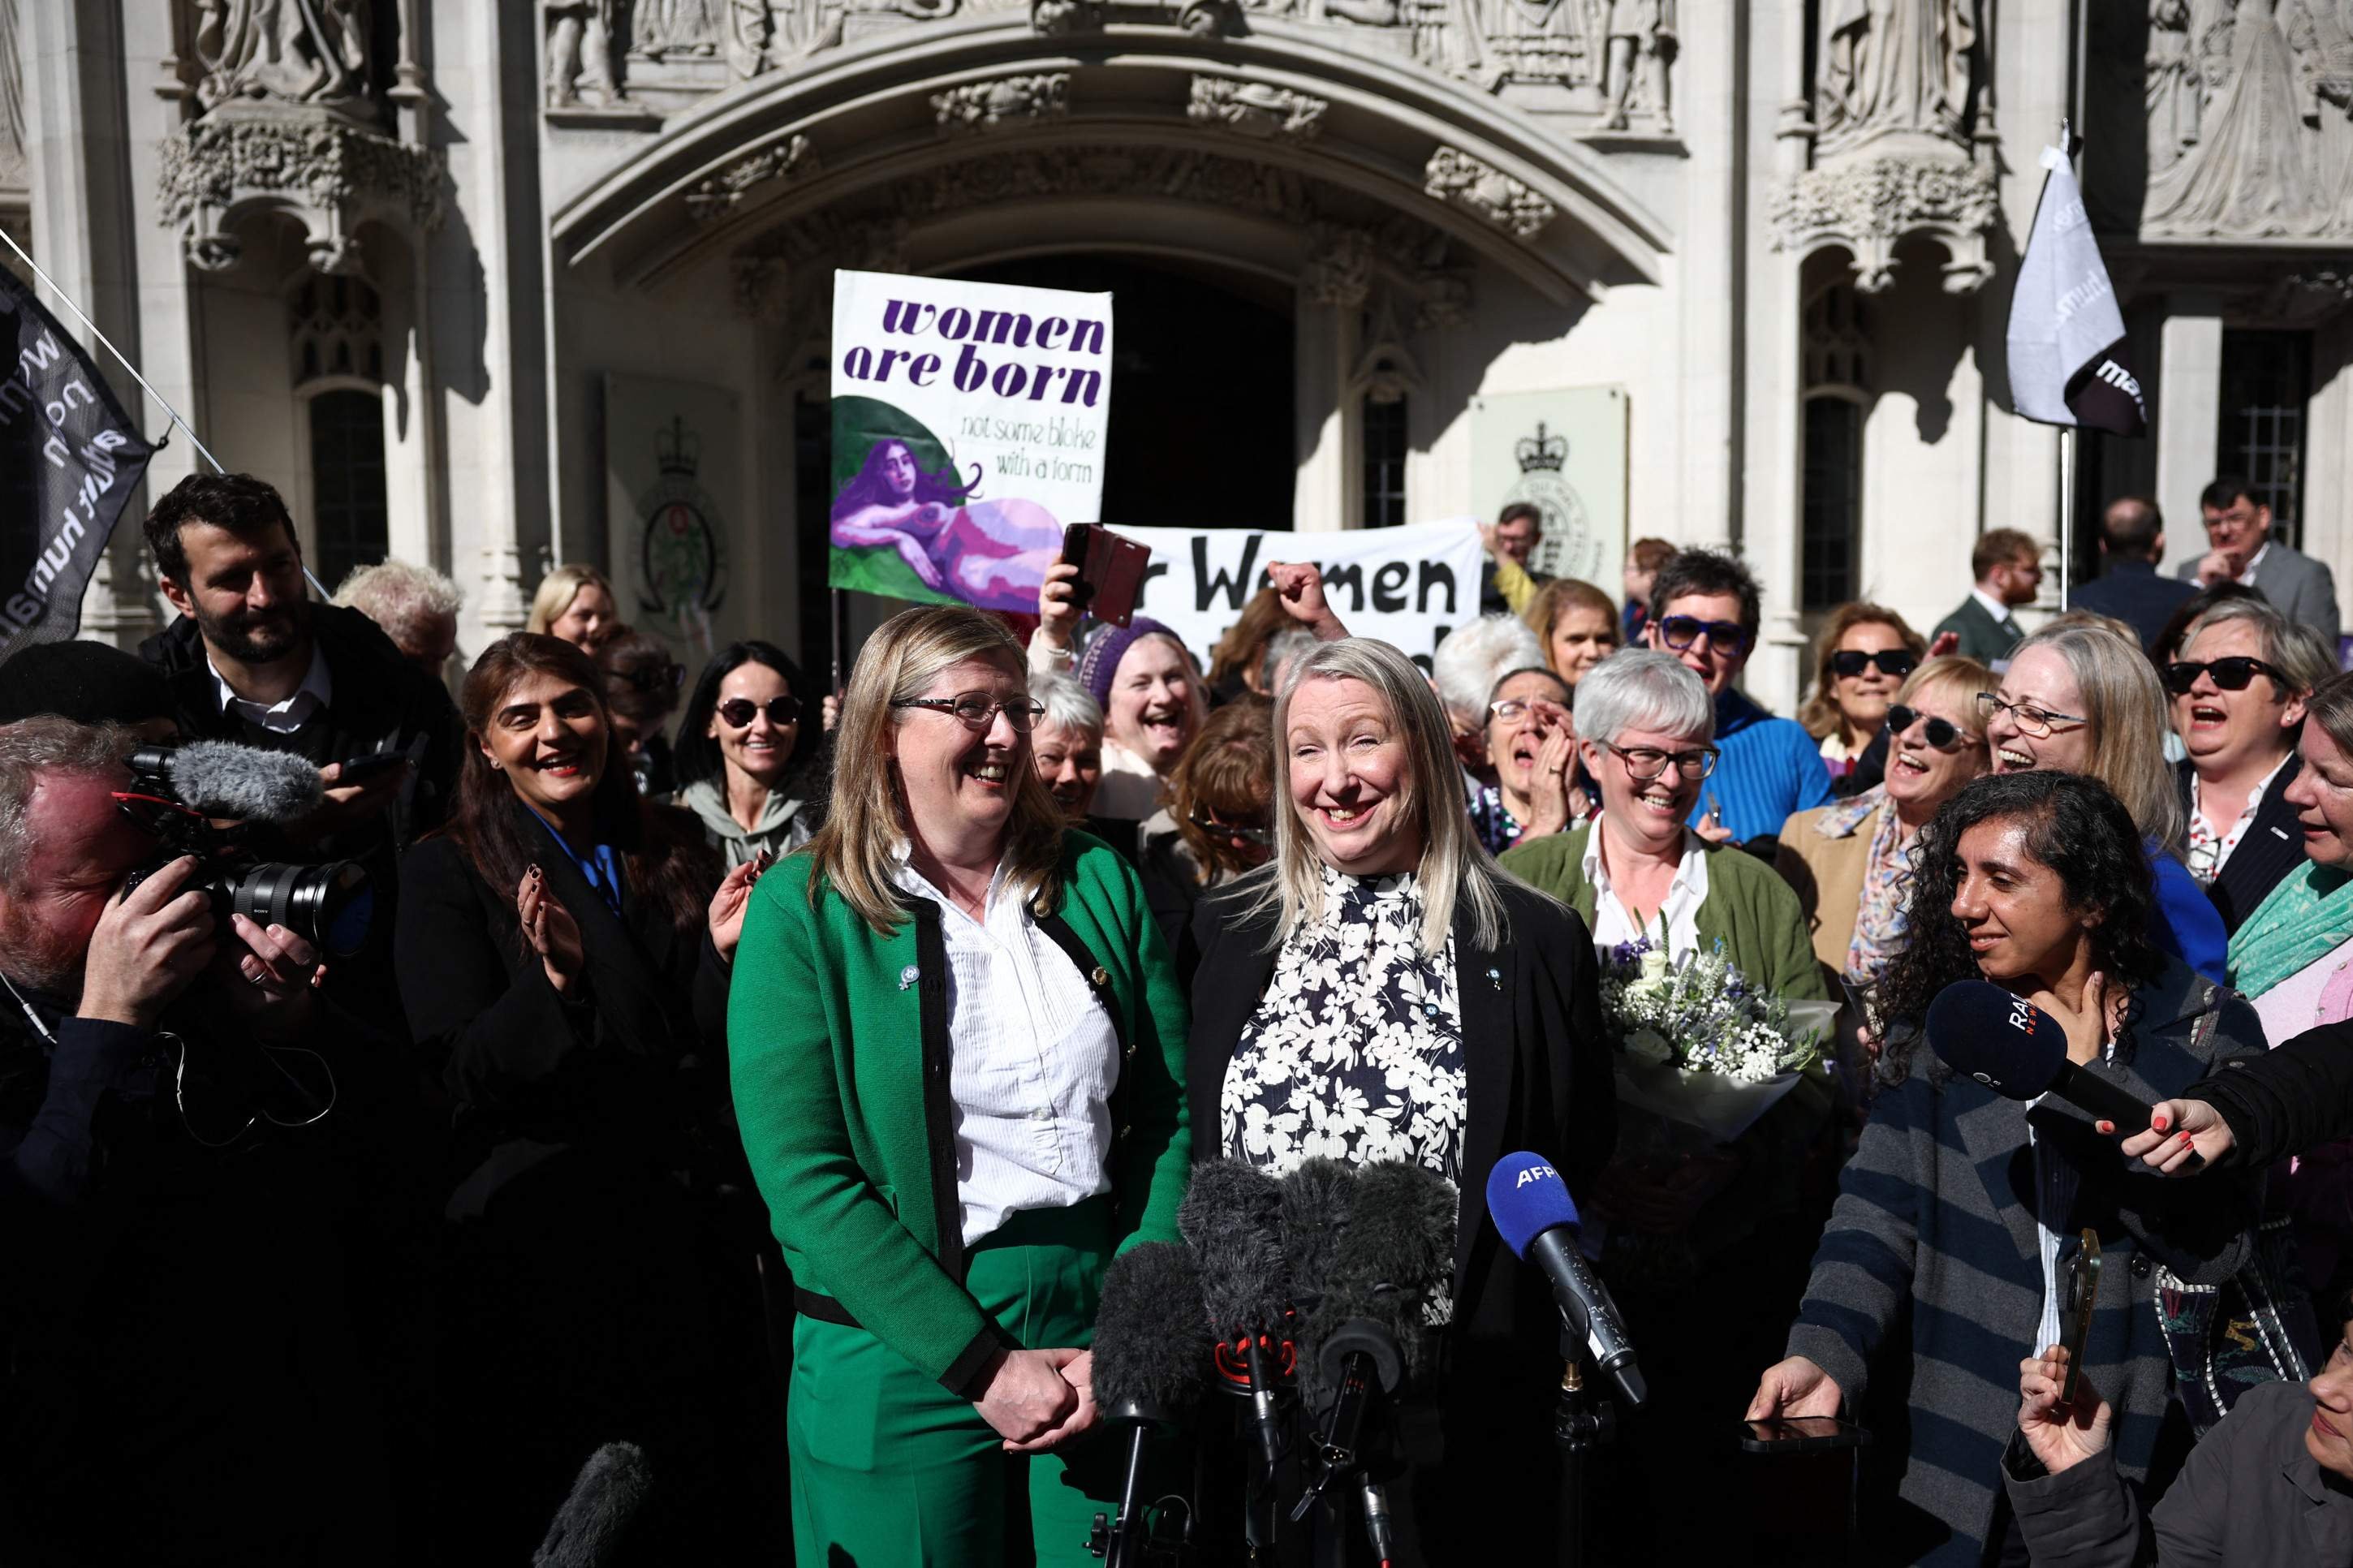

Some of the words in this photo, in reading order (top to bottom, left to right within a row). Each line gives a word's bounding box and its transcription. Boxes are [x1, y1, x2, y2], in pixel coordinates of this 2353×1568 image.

[883, 299, 1104, 355] women
[843, 346, 942, 386] are
[953, 343, 1101, 407] born
[961, 416, 991, 438] not
[994, 418, 1044, 444] some
[1048, 416, 1097, 450] bloke
[997, 447, 1030, 477] with
[1035, 458, 1048, 480] a
[1191, 535, 1457, 614] Wmen
[2026, 1006, 2037, 1035] NEW
[1516, 1165, 1555, 1189] AFP
